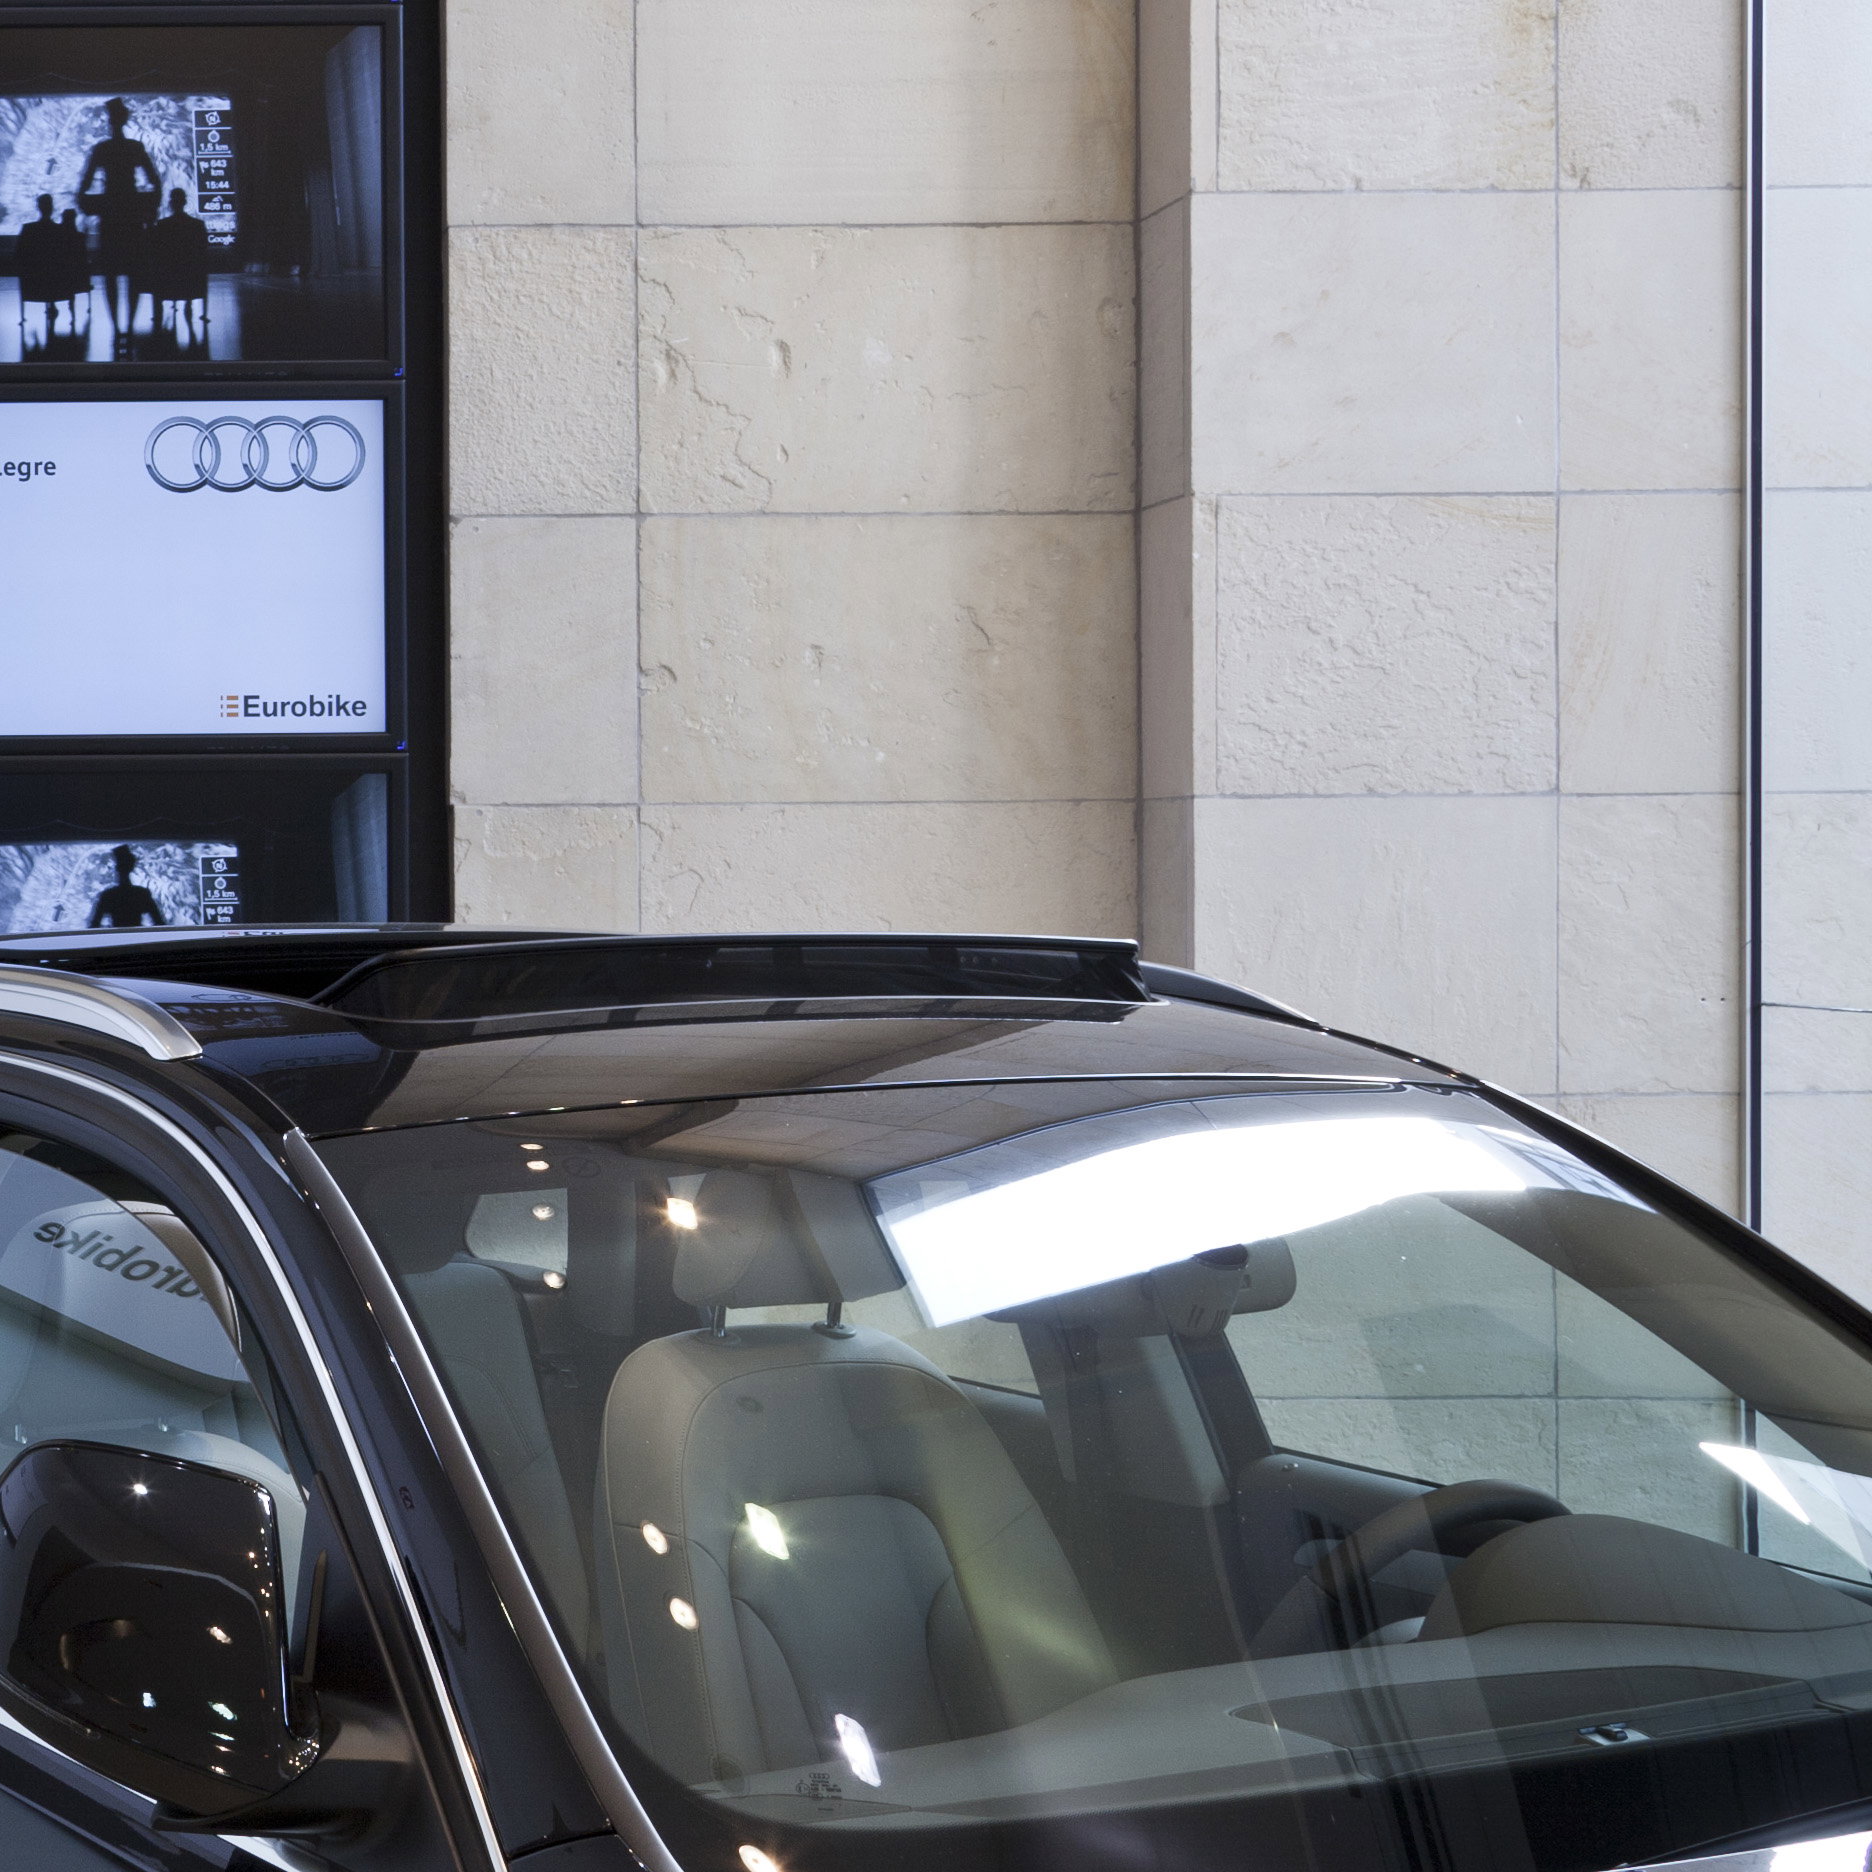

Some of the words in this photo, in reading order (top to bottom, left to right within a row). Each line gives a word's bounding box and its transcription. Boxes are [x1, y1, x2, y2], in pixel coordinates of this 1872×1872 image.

[215, 143, 229, 151] km
[210, 160, 227, 168] 643
[205, 180, 230, 189] 15:44
[243, 693, 368, 718] Eurobike
[222, 889, 235, 897] km
[216, 906, 234, 914] 643
[217, 915, 232, 923] km
